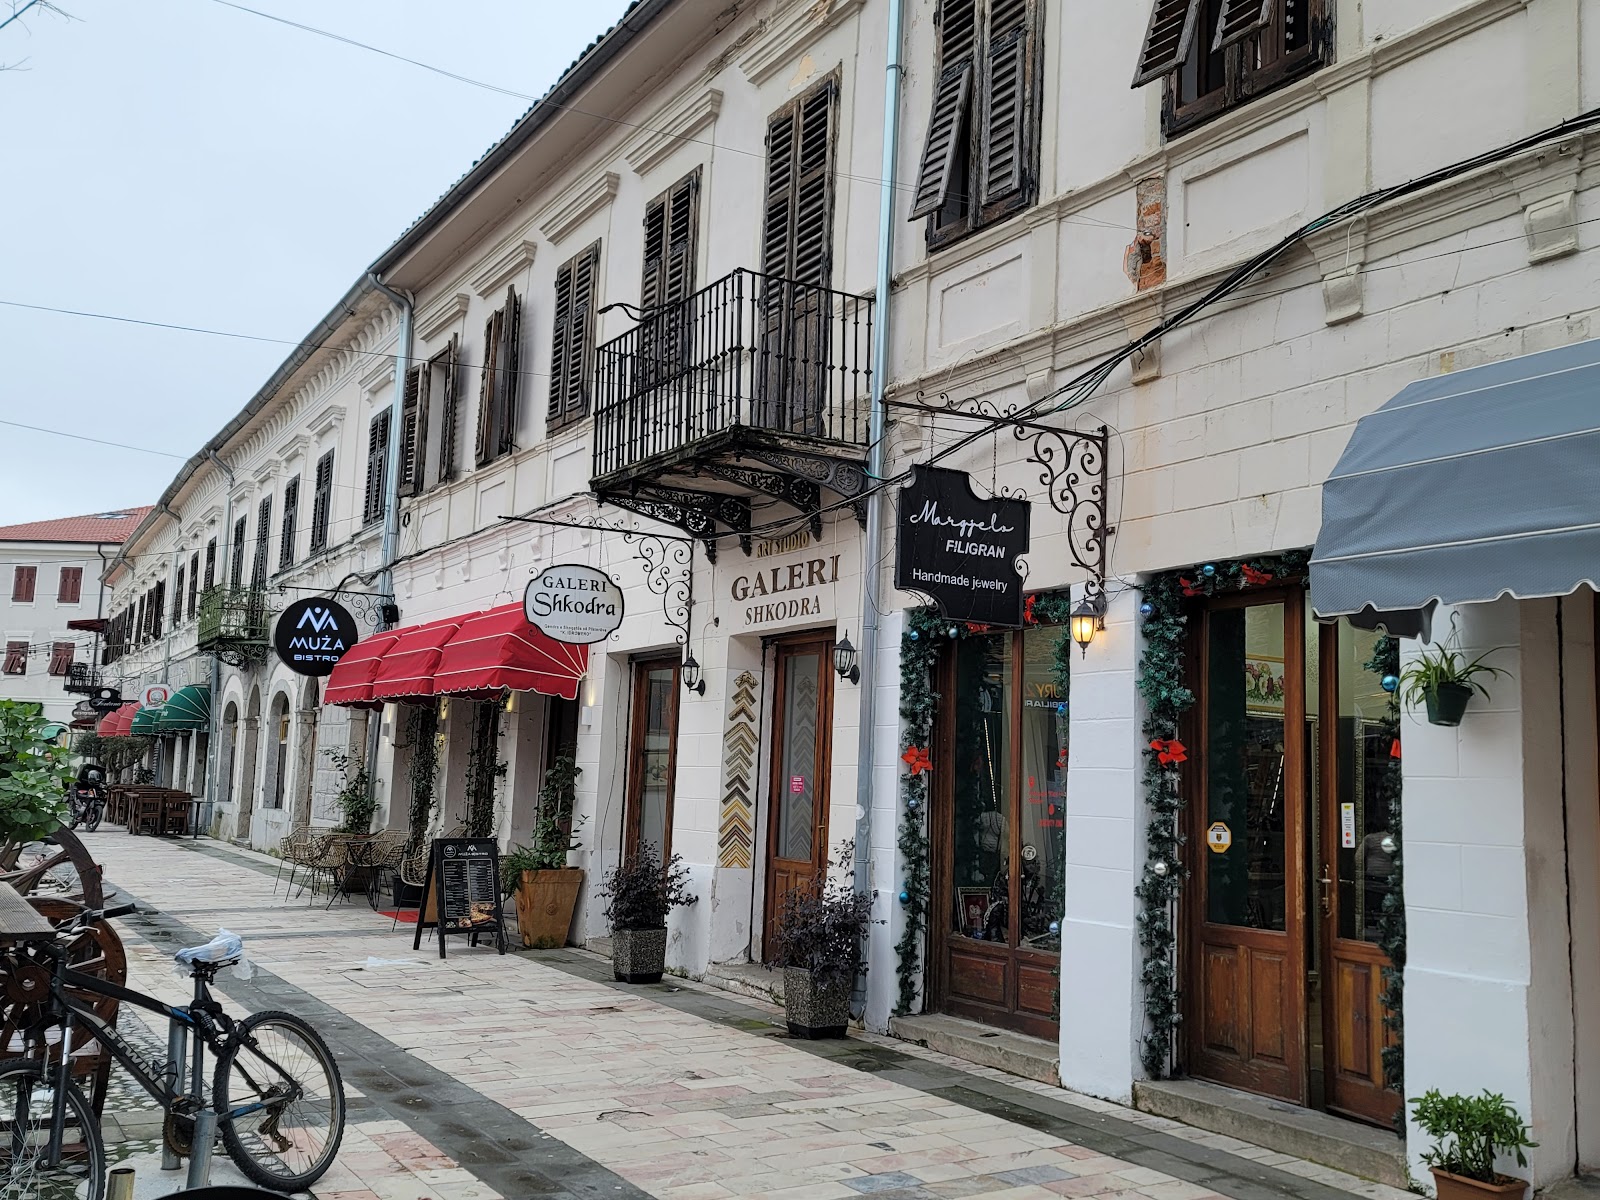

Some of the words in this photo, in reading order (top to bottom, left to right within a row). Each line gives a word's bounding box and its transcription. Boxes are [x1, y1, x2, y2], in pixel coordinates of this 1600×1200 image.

[757, 540, 772, 558] ART
[773, 531, 810, 554] STUDIO
[945, 539, 1005, 558] FILIGRAN
[542, 575, 607, 592] GALERI
[731, 554, 841, 602] GALERI
[912, 567, 970, 587] Handmade
[971, 576, 1008, 594] jewelry
[532, 592, 616, 617] Shkodra
[744, 595, 821, 626] SHKODRA
[288, 634, 345, 651] MUŻA
[293, 654, 339, 662] BISTRO
